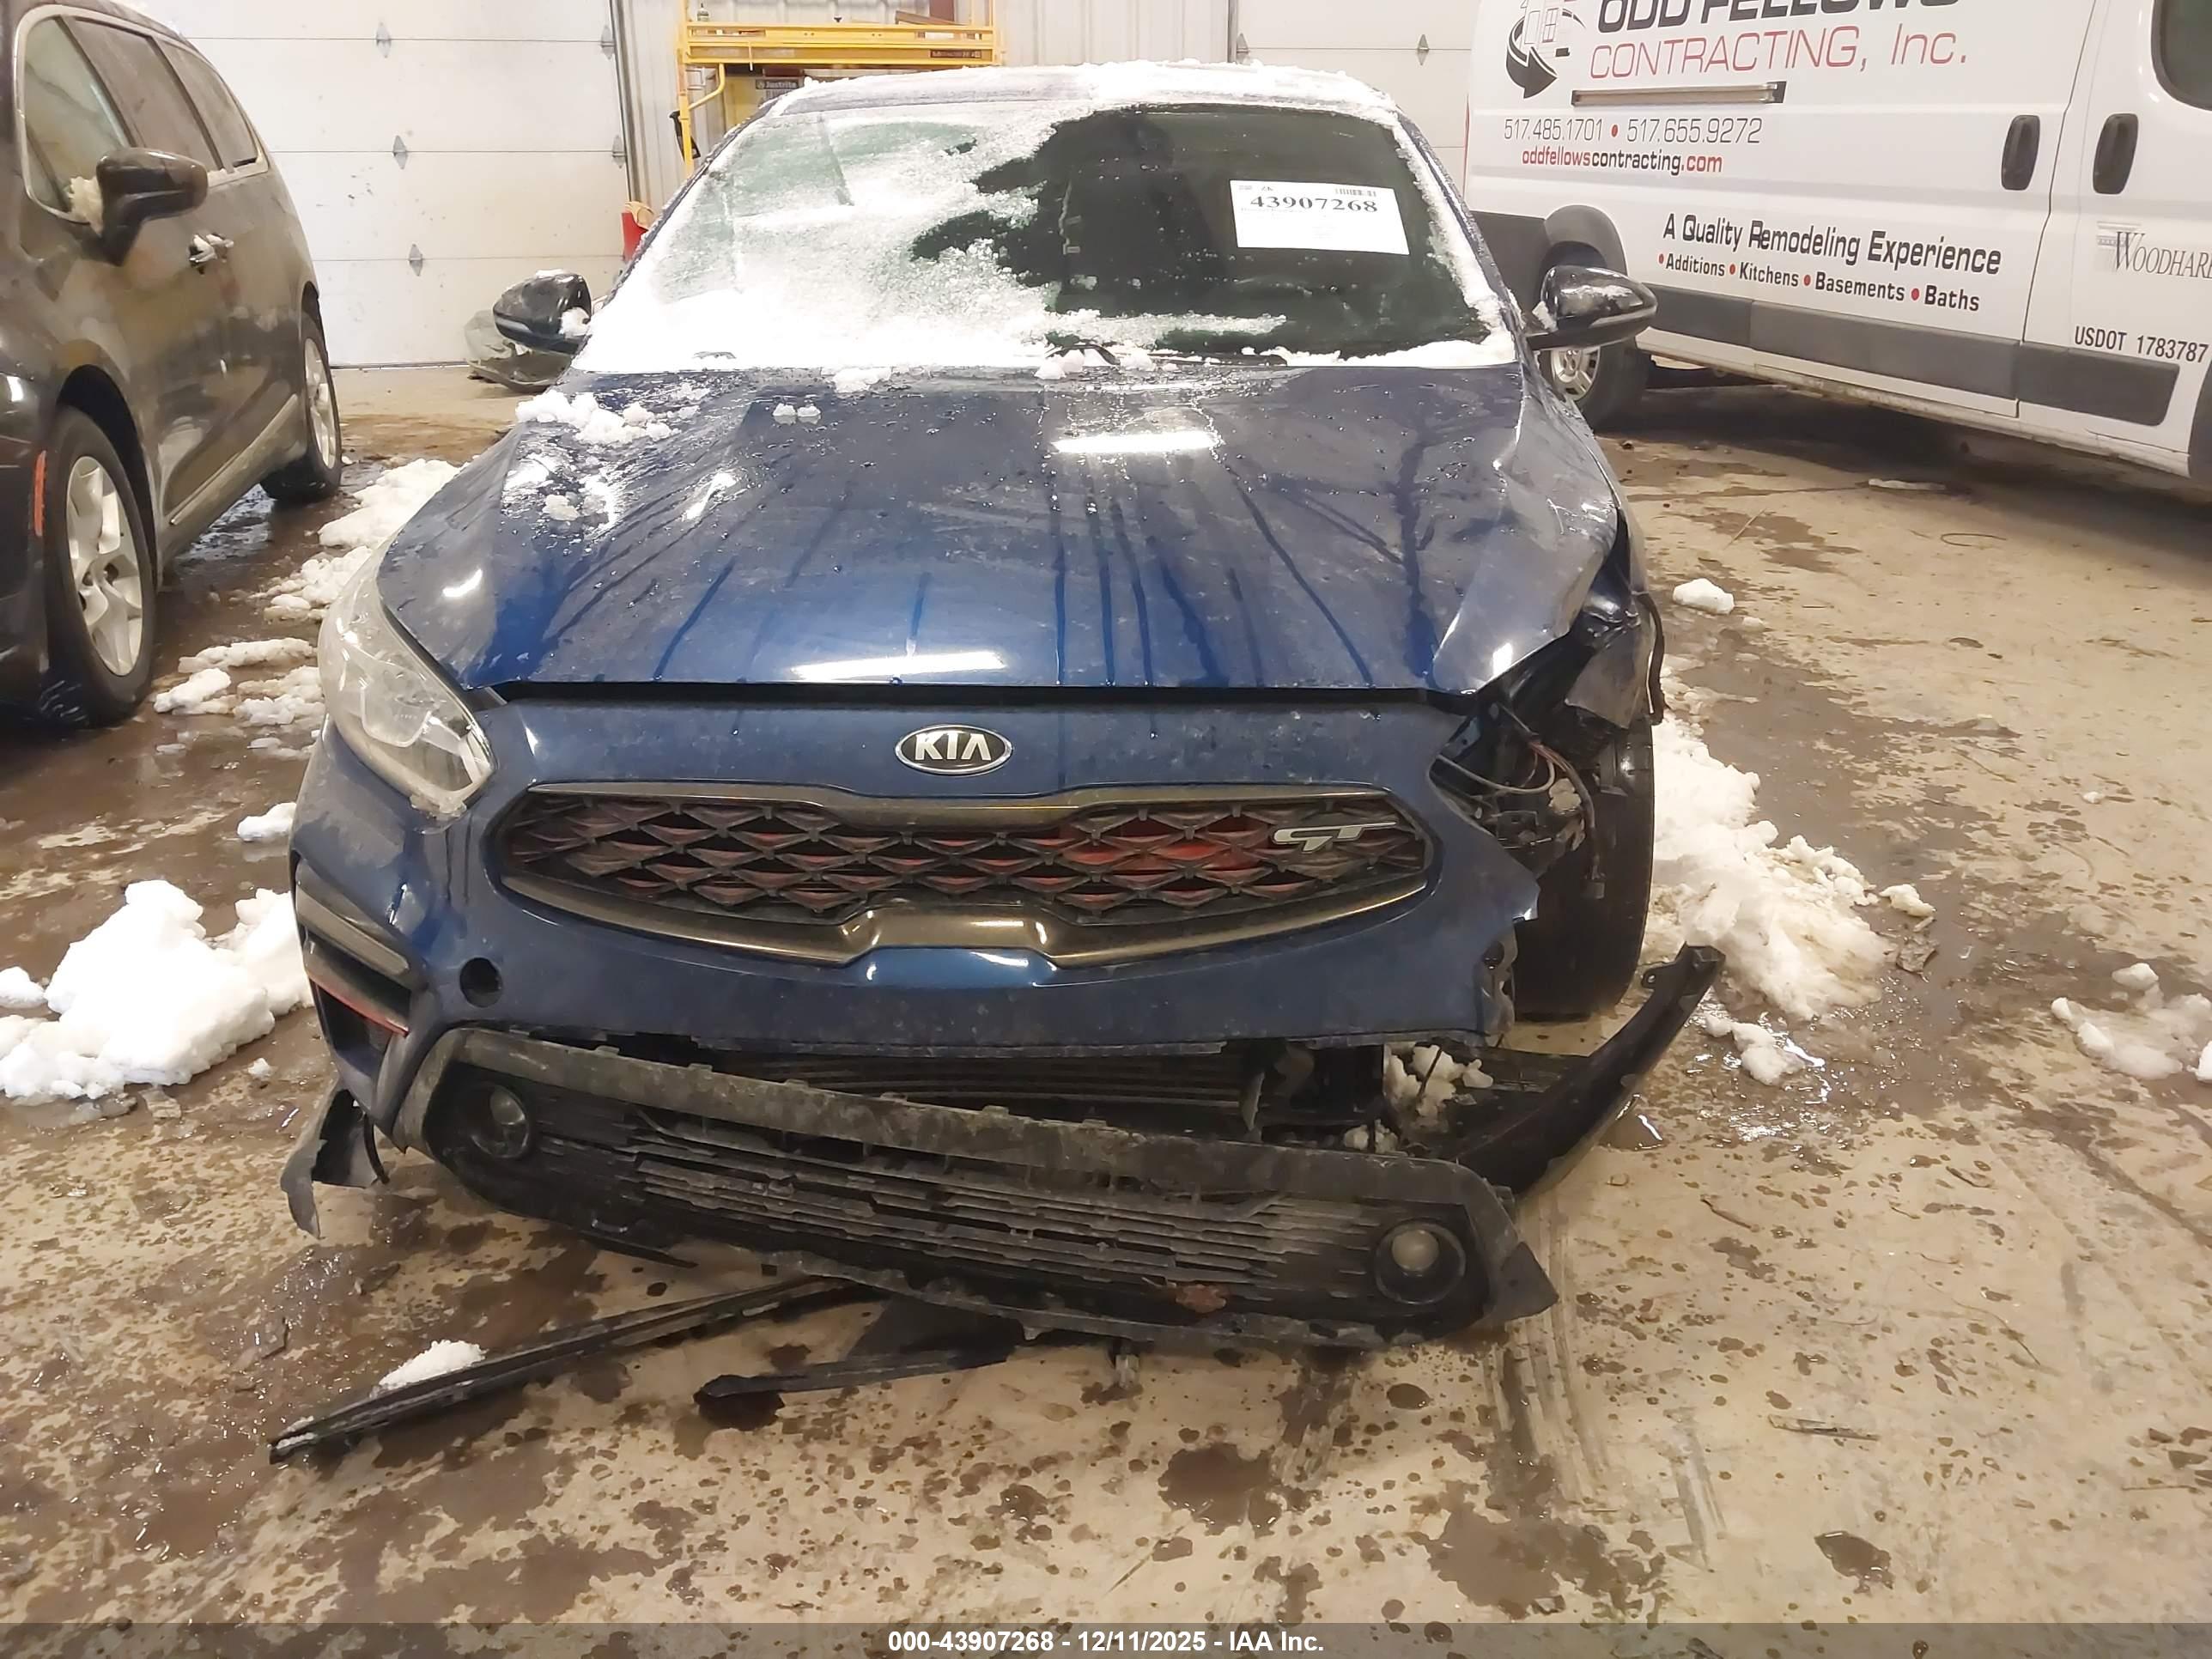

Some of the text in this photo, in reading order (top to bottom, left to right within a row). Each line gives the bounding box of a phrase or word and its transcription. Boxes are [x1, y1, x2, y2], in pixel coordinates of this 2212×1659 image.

[1598, 0, 1691, 33] ODD
[1590, 23, 1967, 79] CONTRACTING, Inc.
[1504, 118, 1763, 144] 517.485.1701 517.655.9272
[1522, 145, 1723, 175] oddfellowscontracting.com
[1250, 196, 1378, 213] 43907268
[1662, 213, 2002, 275] A Quality Remodeling Experience
[2115, 231, 2212, 279] WOODHAR
[1666, 252, 1980, 312] Additions Kitchens Basements Baths
[2075, 325, 2209, 363] USDOT 1783787
[915, 731, 992, 761] KIA
